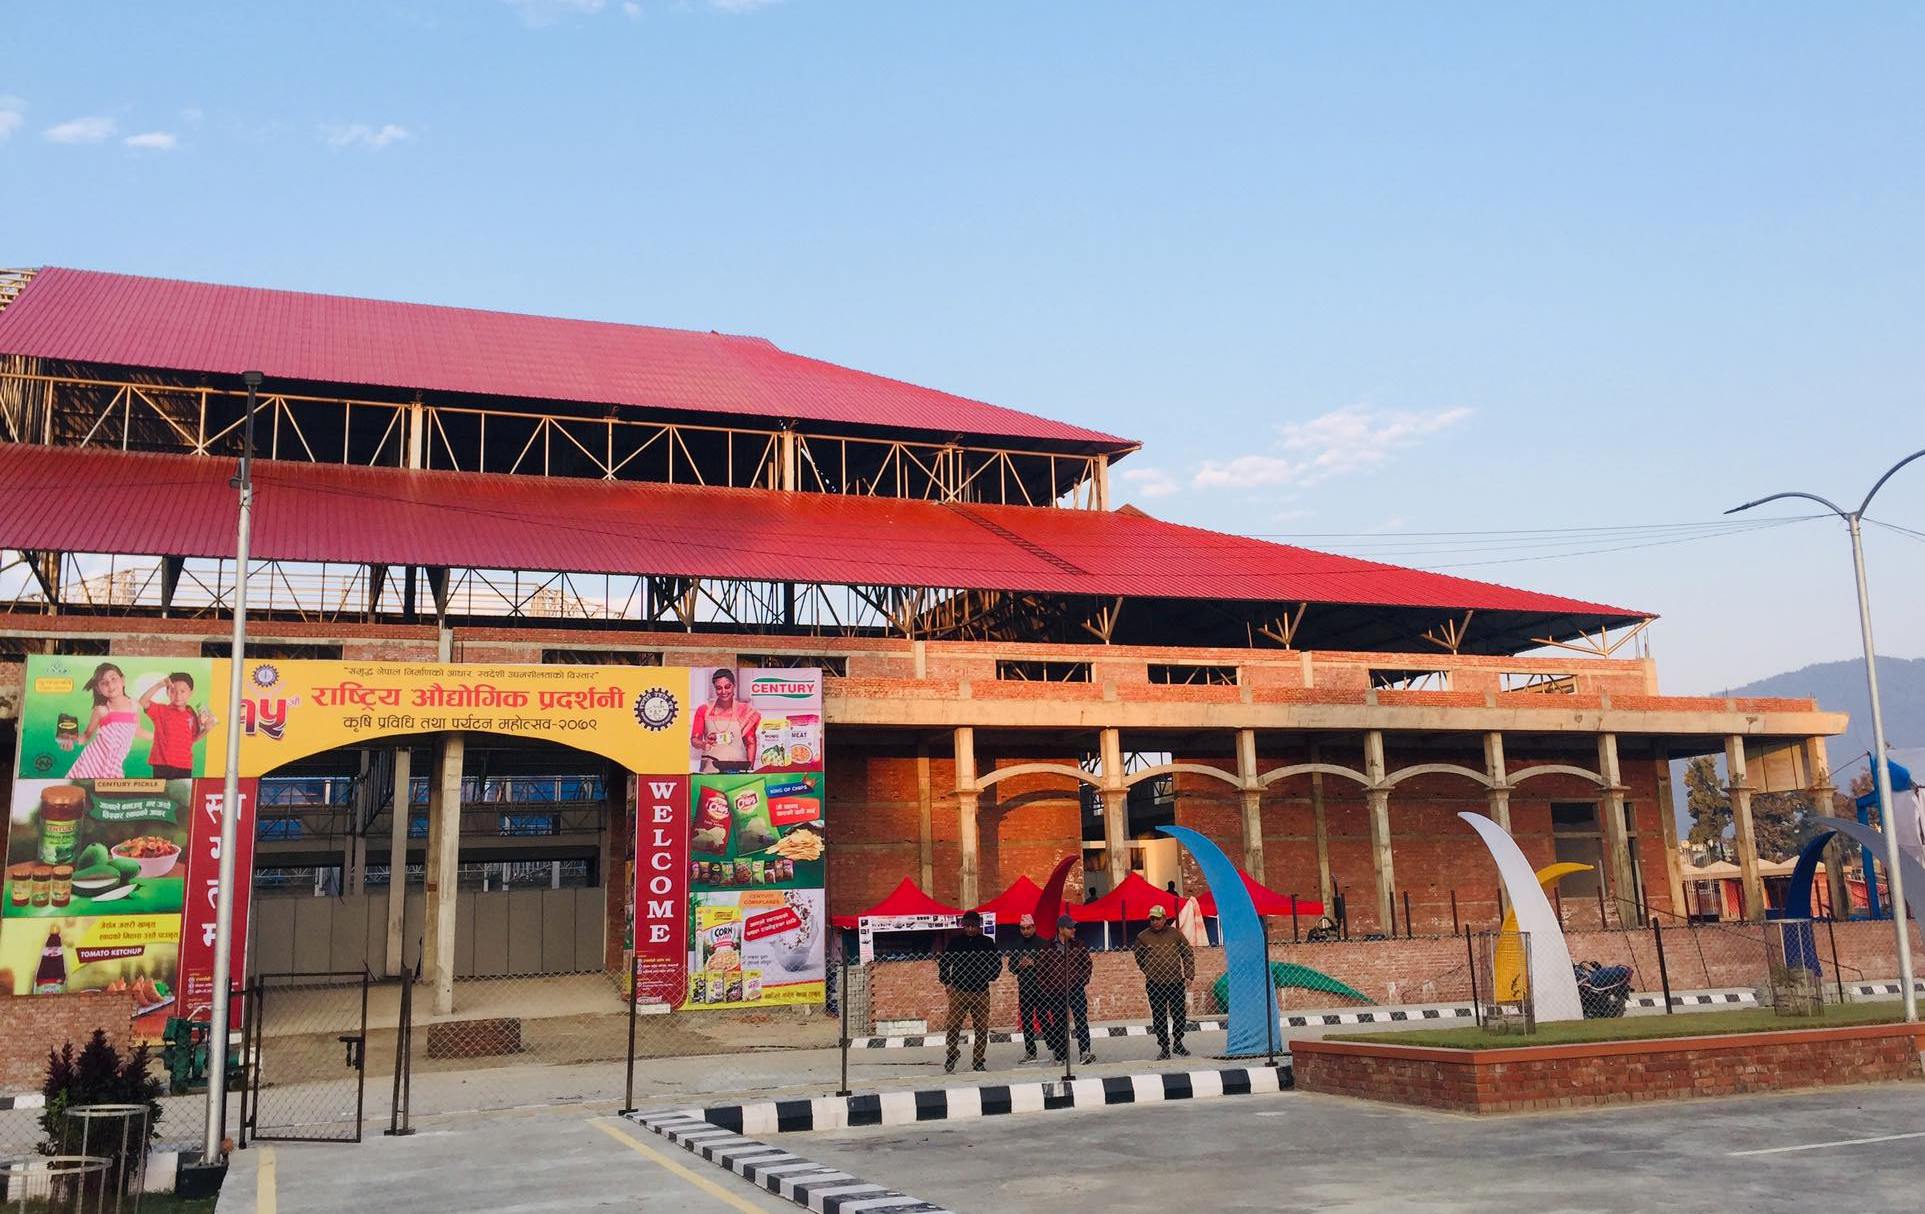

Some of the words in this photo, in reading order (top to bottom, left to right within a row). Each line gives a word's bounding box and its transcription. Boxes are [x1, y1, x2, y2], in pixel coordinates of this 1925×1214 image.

[751, 683, 815, 694] CENTURY
[312, 681, 402, 712] राष्ट्रिय
[411, 683, 530, 708] औद्योगिक
[538, 686, 626, 711] प्रदर्शनी
[344, 714, 372, 733] कृषि
[378, 715, 415, 730] प्रविधि
[421, 717, 446, 730] तथा
[452, 714, 493, 730] पर्यटन
[646, 782, 678, 944] WELCOME
[714, 926, 733, 938] CORN
[80, 949, 110, 958] TOMATO
[111, 947, 143, 956] KETCHUP
